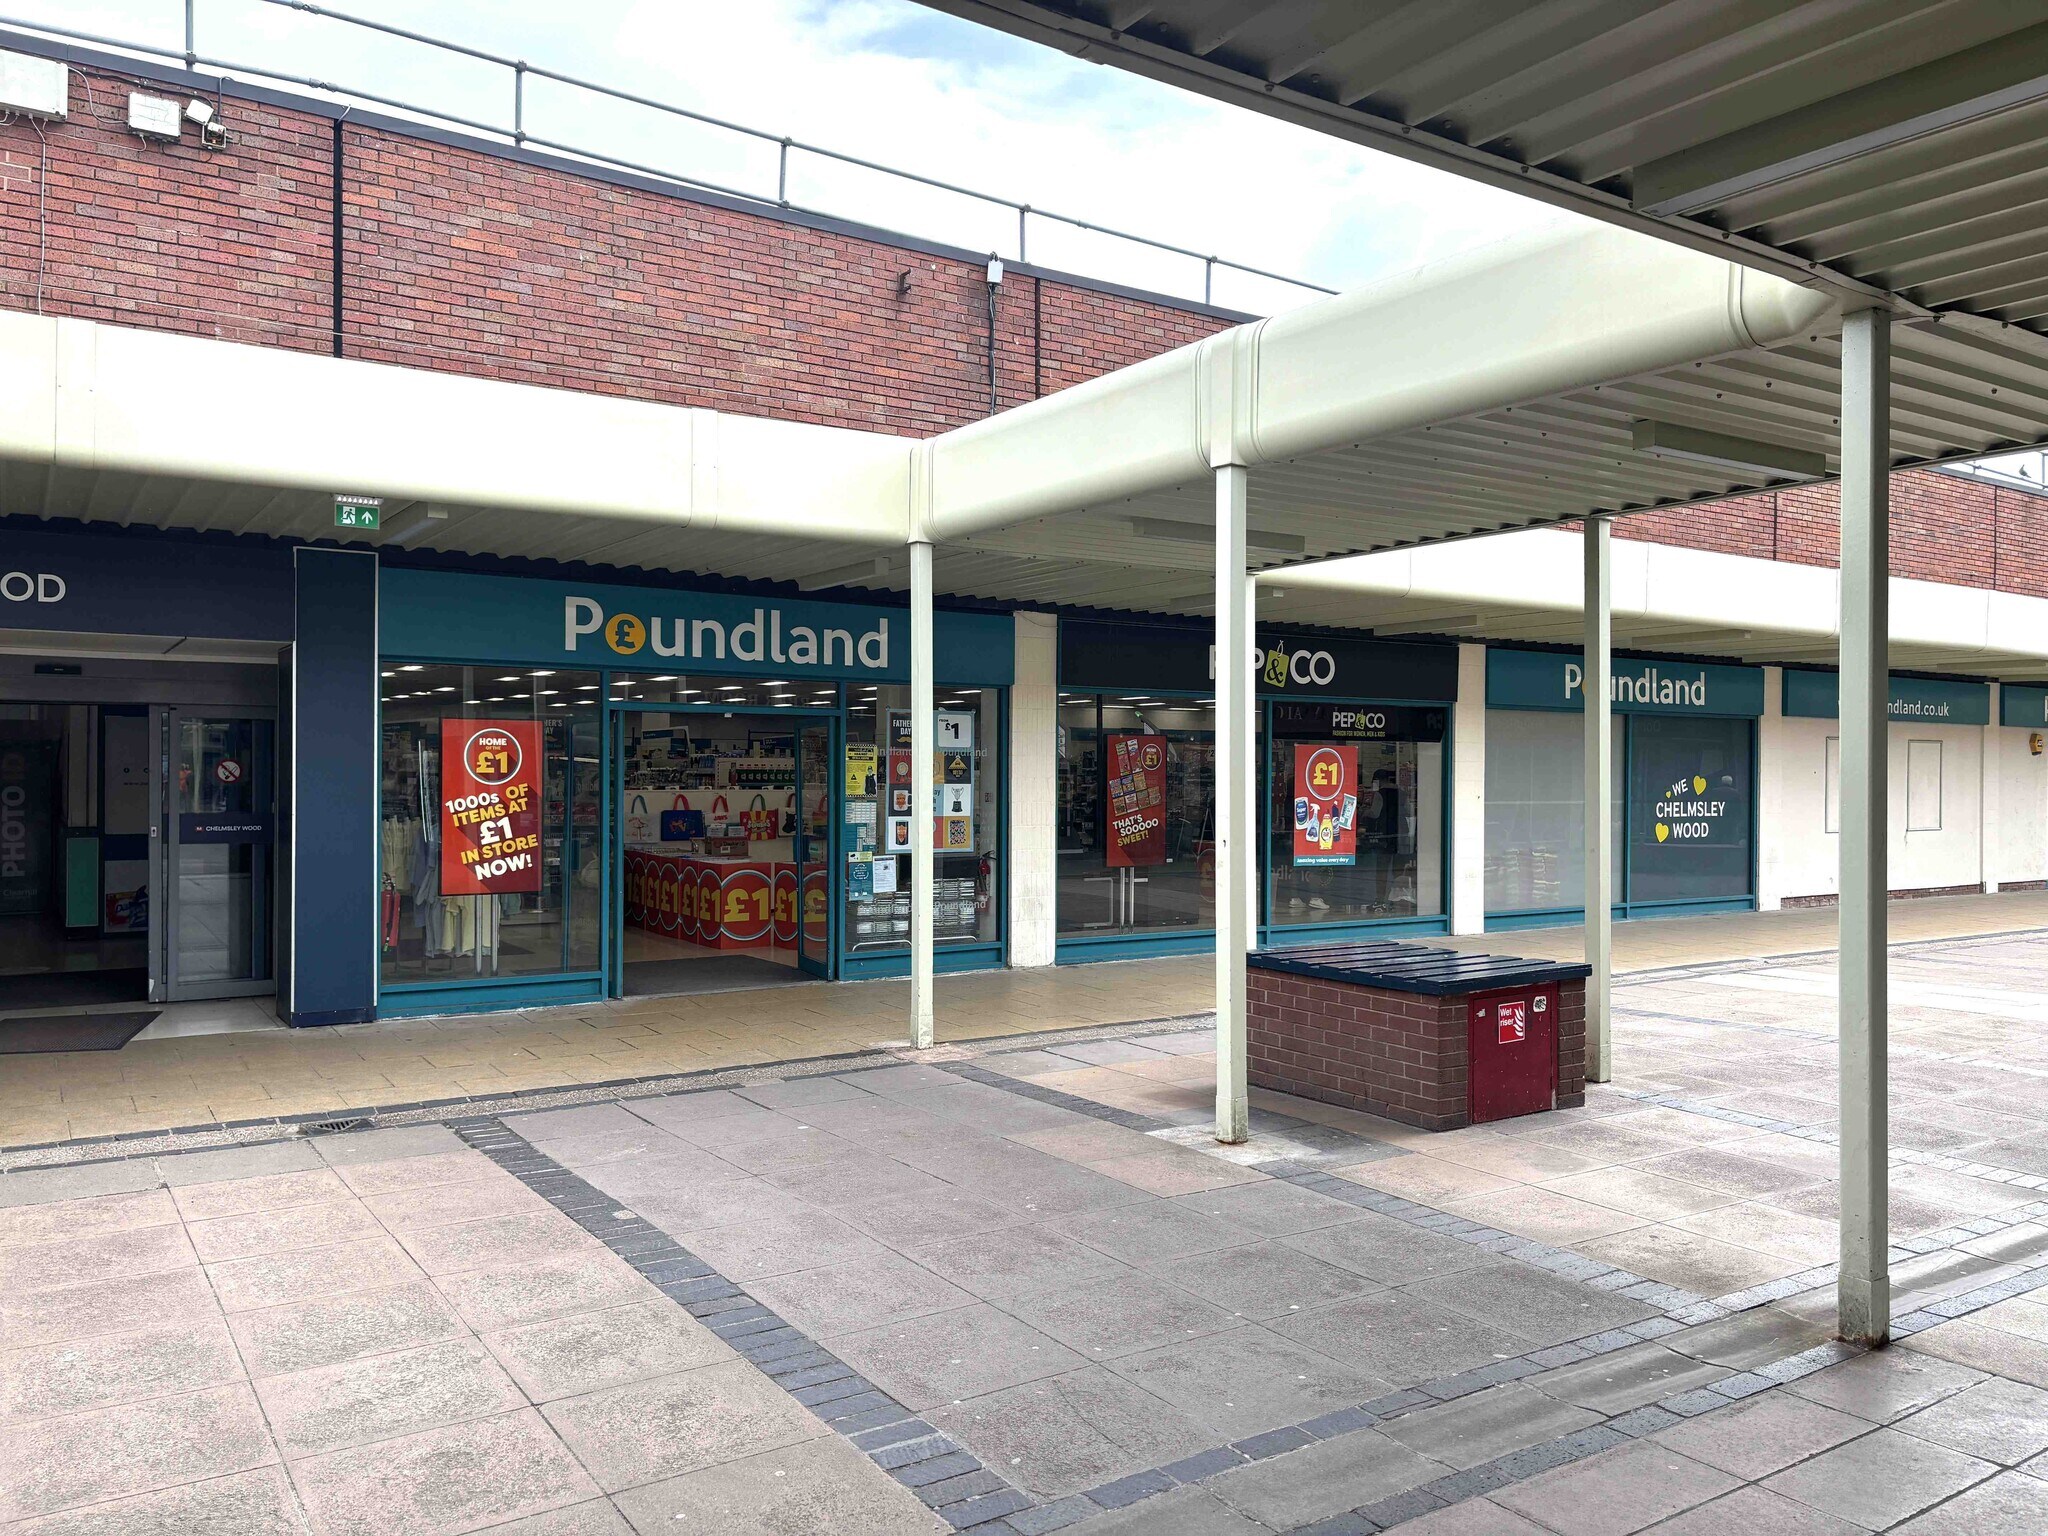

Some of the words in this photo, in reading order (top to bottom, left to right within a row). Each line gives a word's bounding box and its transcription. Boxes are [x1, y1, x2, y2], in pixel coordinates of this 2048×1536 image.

[479, 737, 508, 746] HOME
[945, 723, 959, 740] £1
[476, 751, 508, 774] £1
[1145, 754, 1158, 765] £1
[1313, 762, 1338, 785] £1
[445, 792, 500, 814] 1000s
[505, 783, 529, 799] OF
[1672, 779, 1688, 797] WE
[453, 804, 506, 828] ITEMS
[508, 798, 529, 815] AT
[1656, 801, 1725, 818] CHELMSLEY
[2, 786, 25, 877] PHOTO
[479, 816, 513, 846] £1
[1112, 814, 1143, 830] THAT'S
[1120, 818, 1159, 837] SOOOOO
[1673, 822, 1709, 838] WOOD
[460, 848, 480, 865] IN
[482, 834, 539, 859] STORE
[1117, 830, 1150, 847] SWEET!
[474, 852, 533, 881] NOW!
[661, 882, 679, 914] £1
[682, 884, 697, 918] £1
[700, 886, 721, 923] £1
[723, 887, 769, 923] £1
[1500, 1008, 1512, 1017] Wet
[1500, 1018, 1514, 1027] riser
